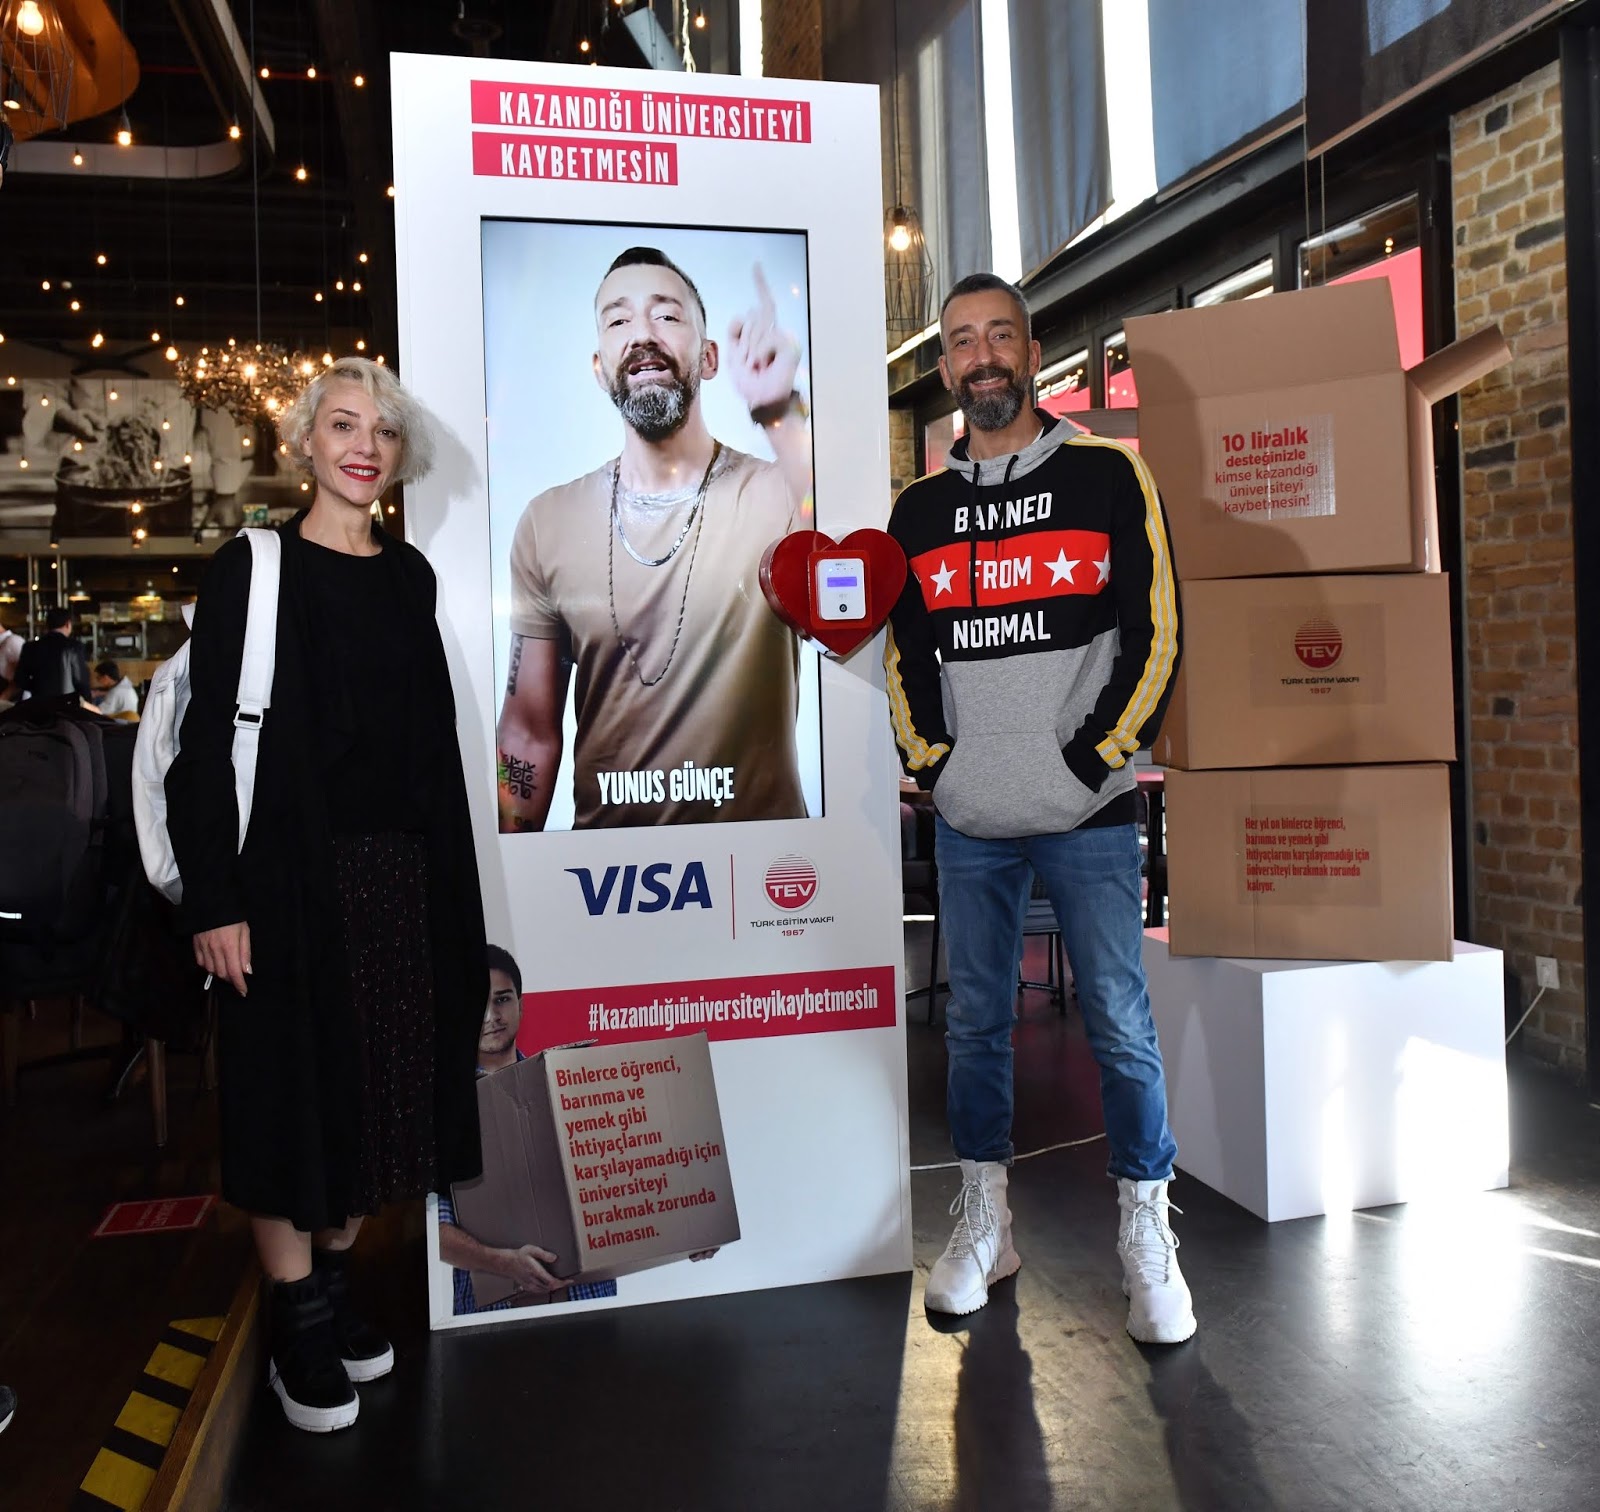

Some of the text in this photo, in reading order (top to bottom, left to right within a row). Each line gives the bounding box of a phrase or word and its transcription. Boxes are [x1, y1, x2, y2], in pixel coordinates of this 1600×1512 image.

[500, 91, 803, 141] KAZANDIĞI ÜNİVERSİTEYİ
[501, 142, 669, 184] KAYBETMESİN
[1222, 426, 1309, 453] 10 liralık
[1226, 449, 1306, 468] desteğinizle
[1215, 462, 1318, 484] kimse kazandığı
[1230, 480, 1304, 498] üniversiteyi
[954, 492, 1053, 534] BANNED
[1224, 494, 1310, 514] kaybetmesin!
[953, 610, 1051, 650] NORMAL
[1298, 645, 1340, 659] TEV
[1281, 677, 1303, 685] TÜRK
[1335, 676, 1360, 684] VAKFI
[597, 761, 735, 808] YUNUS GÜNÇE
[1245, 817, 1258, 829] Her
[1281, 817, 1313, 829] binlerce
[1278, 836, 1287, 845] ve
[1288, 833, 1313, 847] yemek
[1314, 833, 1329, 847] gibi
[1355, 849, 1370, 863] için
[1246, 864, 1291, 878] üniversiteyi
[1329, 864, 1361, 876] zorunda
[563, 861, 713, 916] VISA
[769, 883, 814, 898] TEV
[750, 920, 775, 928] TÜRK
[809, 916, 834, 924] VAKFI
[781, 929, 805, 937] 1967
[588, 983, 878, 1032] #kazandığıüniversiteyikaybetmesin
[555, 1055, 682, 1087] Binlerce öğrenci,
[561, 1087, 645, 1111] barınma ve
[565, 1107, 648, 1139] yemek gibi
[570, 1131, 662, 1160] ihtiyaçlarını
[574, 1142, 721, 1181] karşılayamadığı için
[579, 1173, 668, 1204] üniversiteyi
[583, 1188, 717, 1227] bırakmak zorunda
[587, 1223, 660, 1250] kalmasın.
